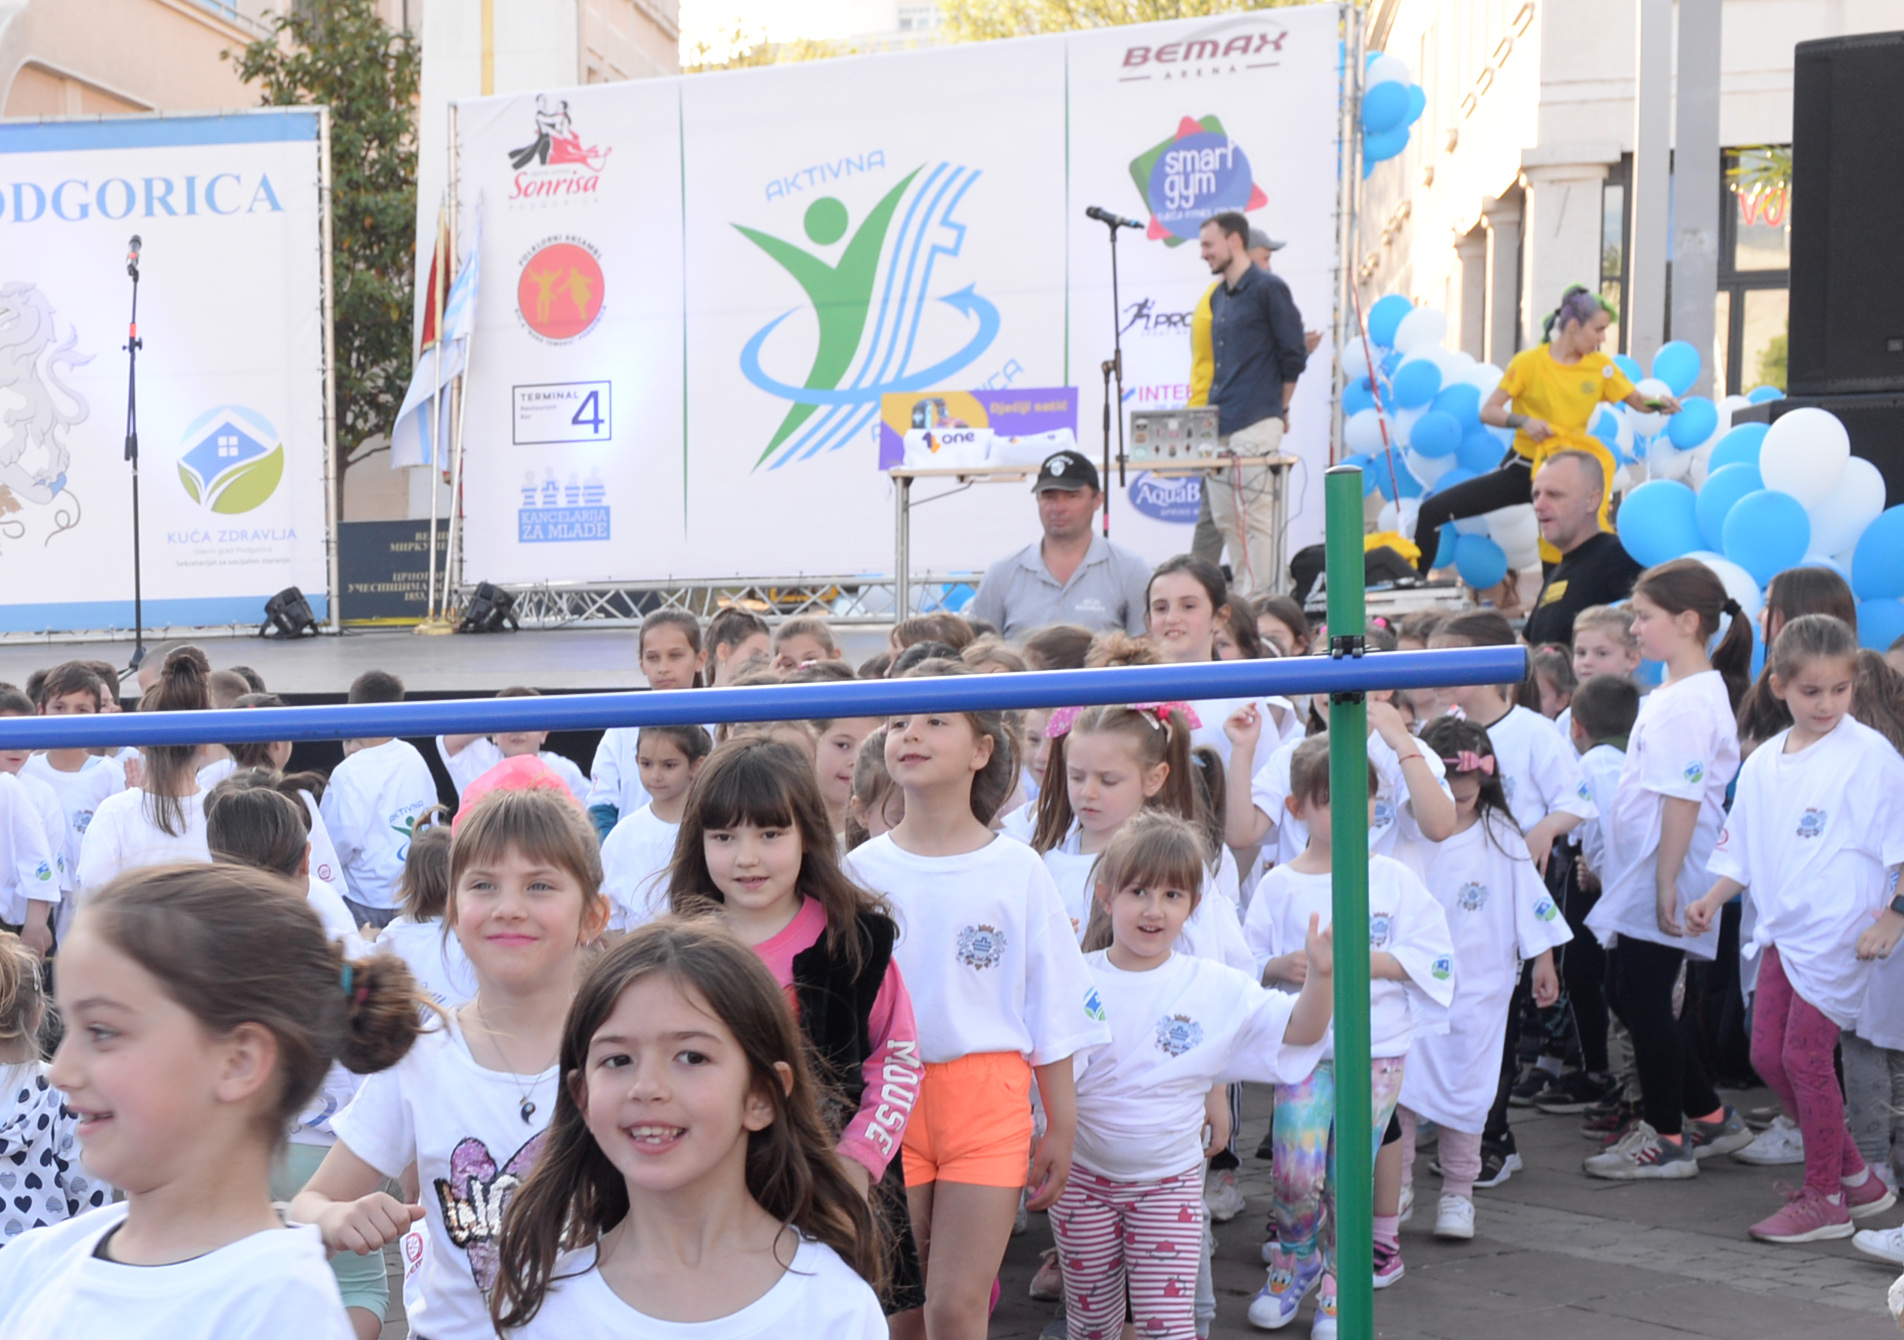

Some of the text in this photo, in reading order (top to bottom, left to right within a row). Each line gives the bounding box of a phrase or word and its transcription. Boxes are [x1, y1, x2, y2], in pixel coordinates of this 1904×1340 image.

[1122, 31, 1289, 68] BEMAX
[1164, 65, 1238, 81] ARENA
[509, 170, 599, 200] Sonrisa
[765, 149, 886, 203] AKTIVNA
[1164, 170, 1216, 210] gym
[520, 389, 605, 434] TERMINAL 4
[941, 432, 976, 445] one
[521, 510, 607, 523] KANCELARIJA
[522, 523, 607, 539] ZA MLADE
[167, 527, 298, 544] KUĆA ZDRAVLJA
[864, 1039, 922, 1156] MOUSE
